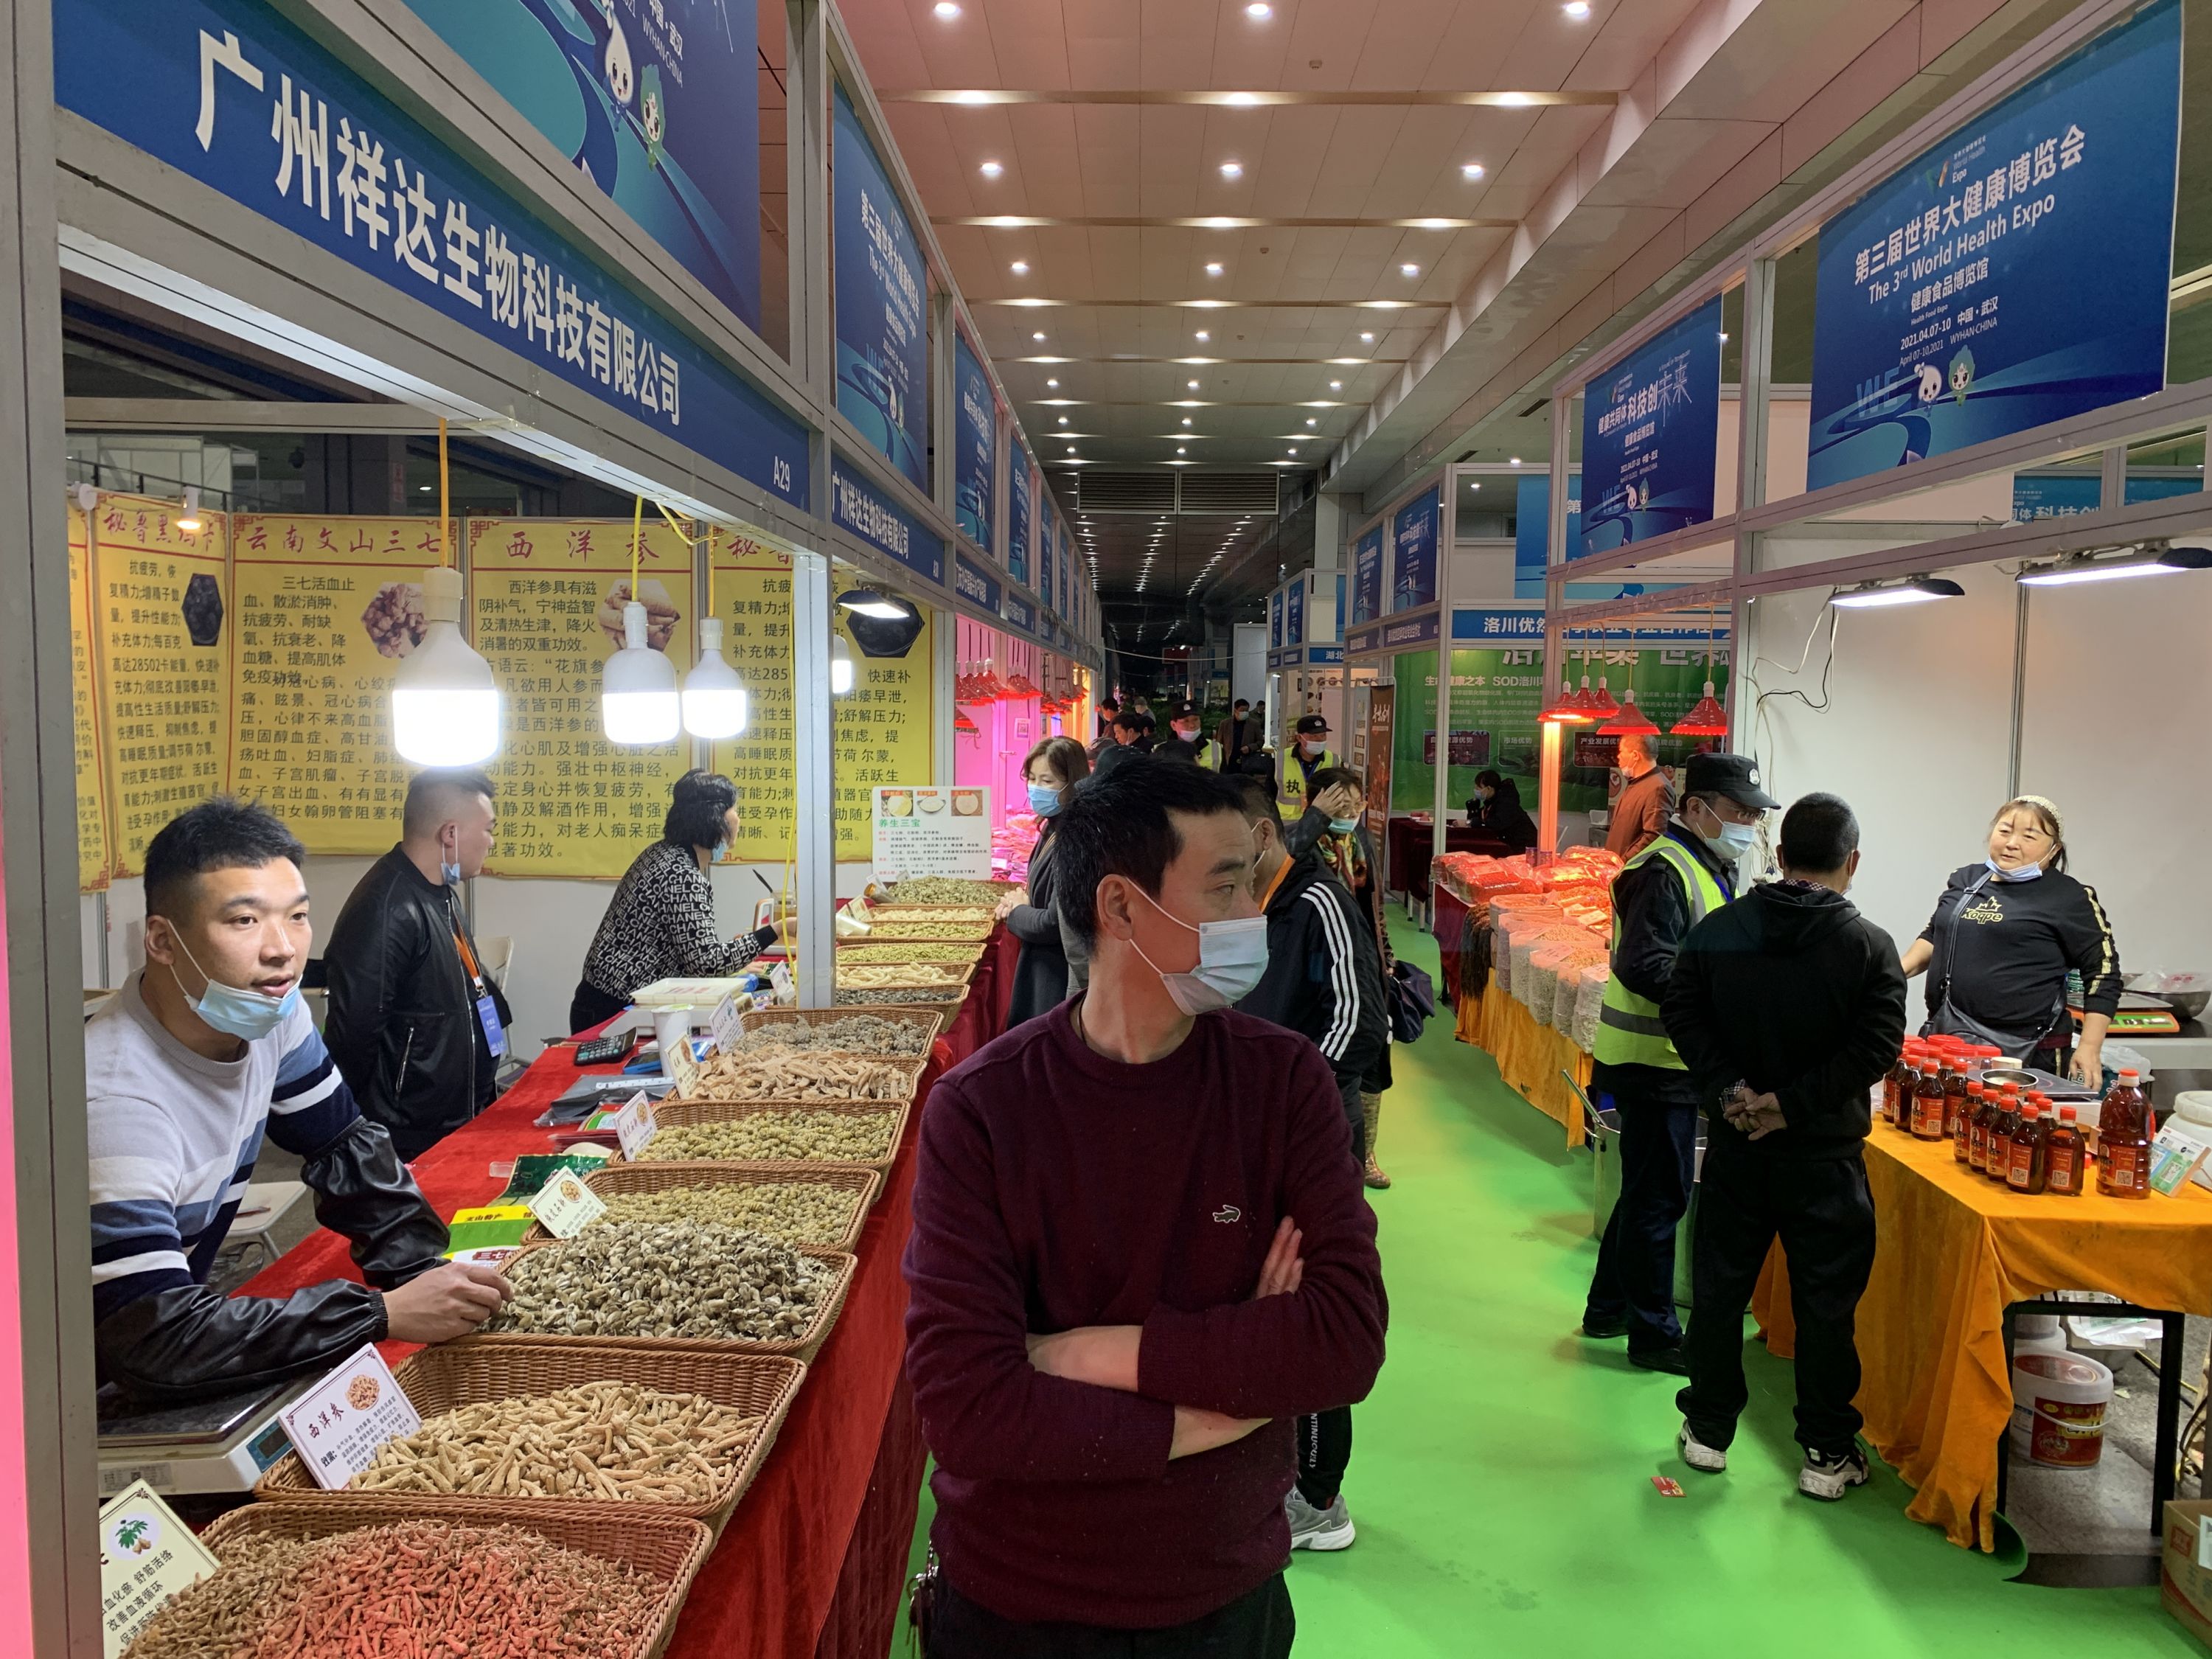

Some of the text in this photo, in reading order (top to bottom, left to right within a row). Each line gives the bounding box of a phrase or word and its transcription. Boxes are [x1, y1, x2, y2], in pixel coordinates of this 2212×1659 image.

[1952, 168, 1967, 184] Expo
[1854, 123, 2086, 285] 第三届世界大健康博览会
[195, 28, 681, 425] 广州祥达生物科技有限公司
[1869, 194, 2056, 304] The 3rd World Health Expo
[1911, 257, 1989, 313] 健康食品博览馆
[1900, 295, 1999, 350] 2021.04.07-10 中国·武汉
[1910, 304, 1949, 326] Health Food Expo
[1899, 350, 1913, 367] April
[1913, 339, 1944, 361] 07-10,2021
[773, 455, 790, 493] A29
[832, 470, 909, 560] 广州祥达生物科技有限公司
[246, 524, 442, 554] 云南文山三七
[506, 529, 660, 566] 西洋参
[282, 576, 356, 591] 三七活血止
[508, 580, 597, 595] 西洋参具有滋
[243, 593, 338, 610] 血、散淤消肿、
[479, 598, 596, 615] 阴补气，宁神益智
[243, 612, 332, 629] 抗疲劳、耐缺
[479, 617, 597, 633] 及清热生津，降火
[1484, 616, 1545, 635] 洛川优然
[243, 630, 347, 648] 氧、抗衰老、降
[479, 636, 589, 652] 消暑的双重功效。
[243, 650, 347, 667] 血糖、提高肌体
[732, 644, 790, 659] 补充体力
[867, 669, 911, 684] 快速补
[240, 728, 395, 745] 胆固醇血症、高甘油
[734, 746, 792, 761] 高睡眠质
[484, 759, 669, 777] 动能力。强壮中枢神经，
[734, 766, 792, 781] 对抗更年
[237, 785, 404, 802] 女子宫出血、有有显有
[1286, 779, 1301, 793] 执
[493, 800, 672, 818] 静及解酒作用，增强
[879, 818, 921, 828] 养生三宝
[487, 841, 565, 858] 显著功效。
[308, 1402, 344, 1439] 西洋参
[133, 1549, 174, 1585] 舒筋活络
[106, 1580, 164, 1632] 改善血液循环
